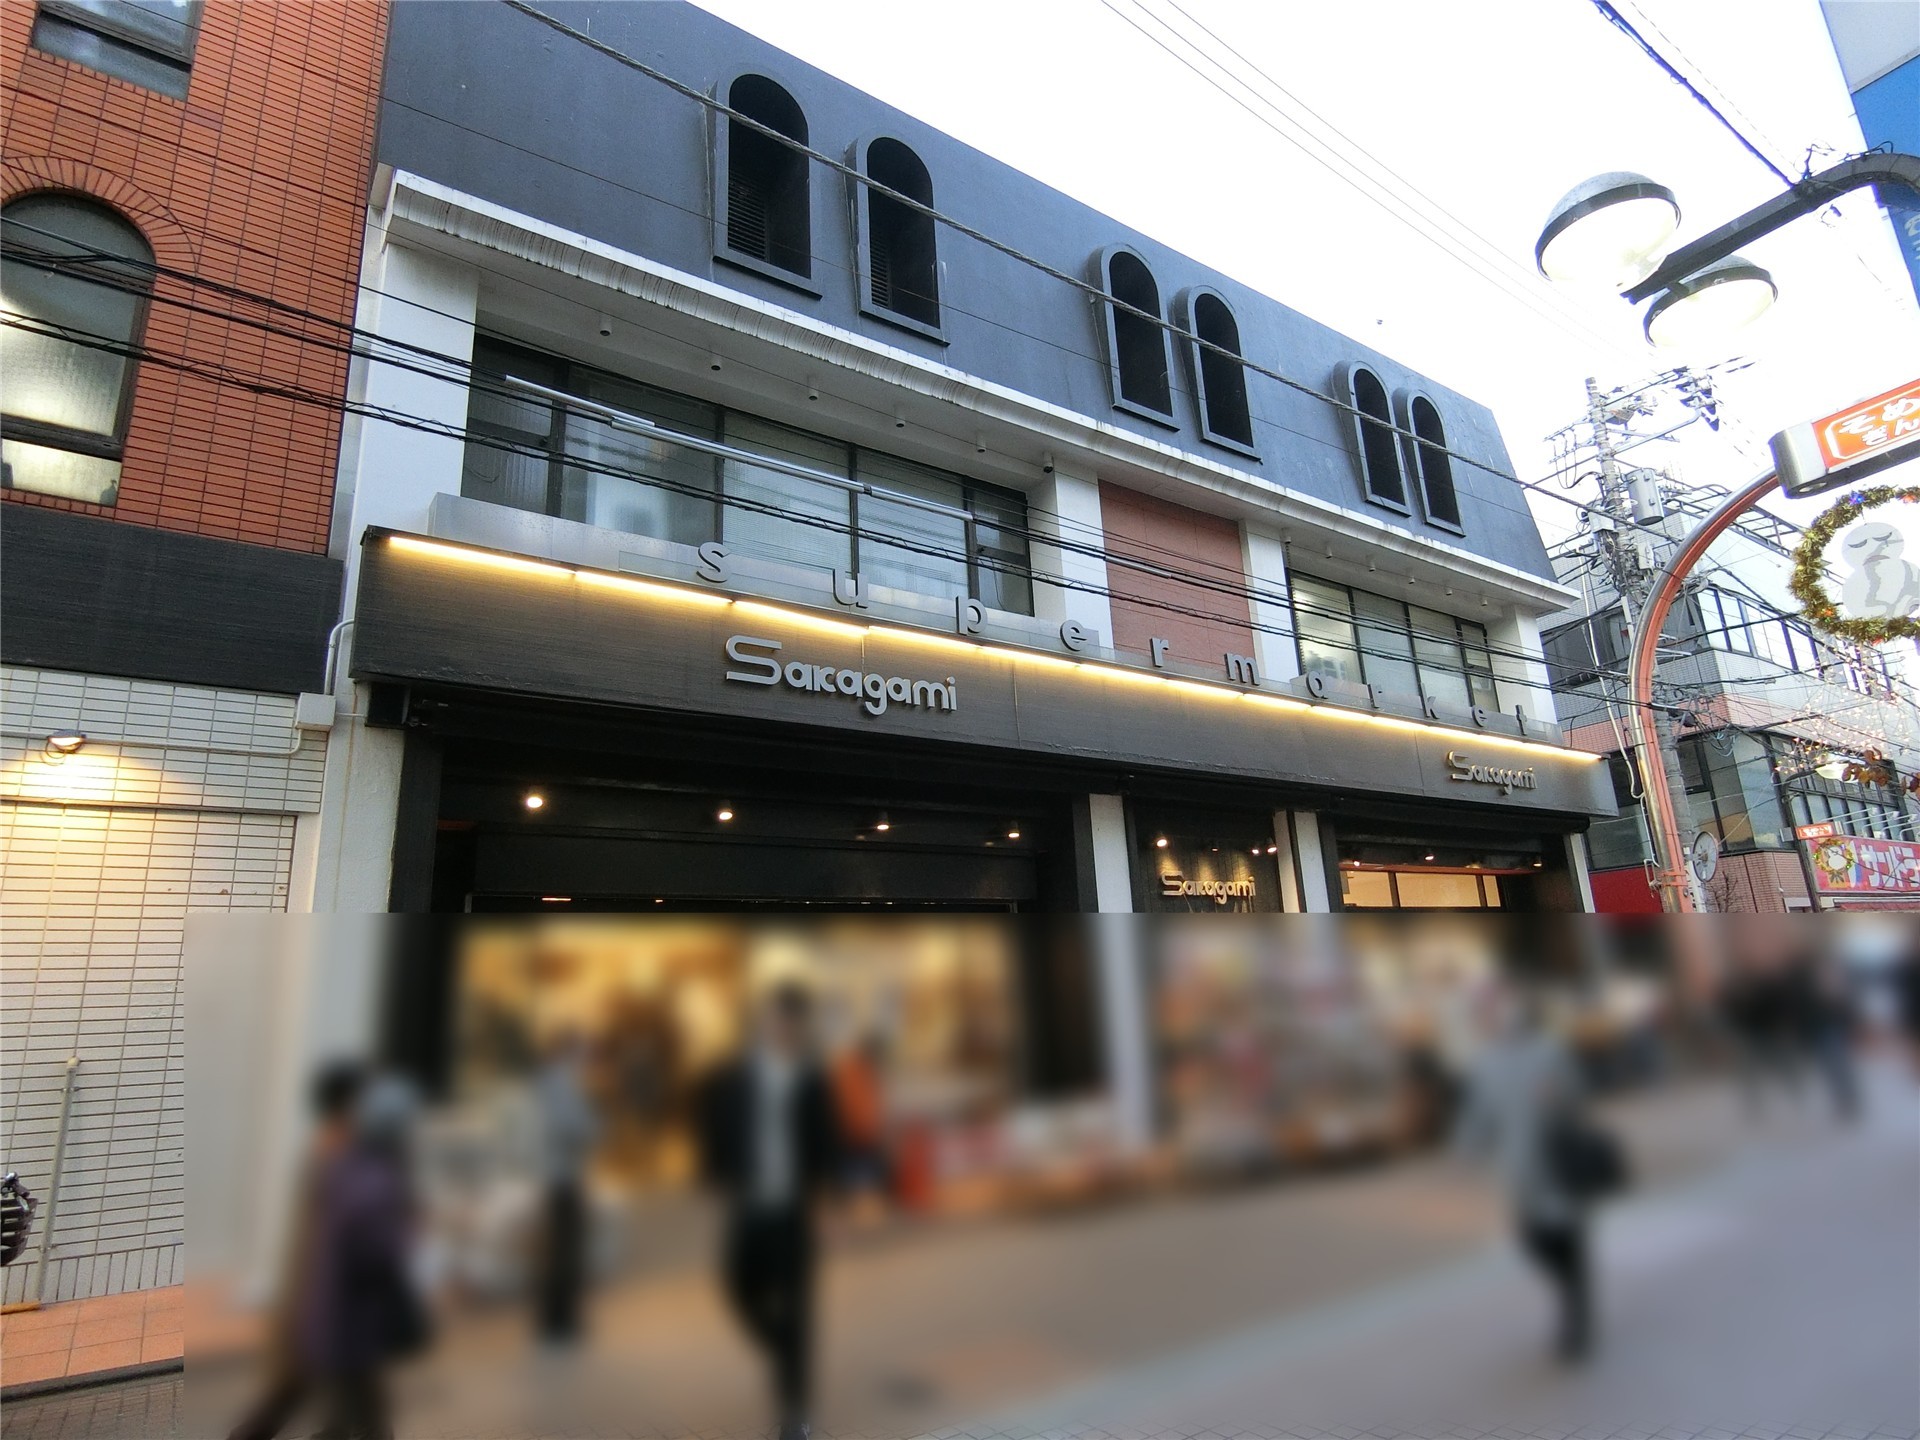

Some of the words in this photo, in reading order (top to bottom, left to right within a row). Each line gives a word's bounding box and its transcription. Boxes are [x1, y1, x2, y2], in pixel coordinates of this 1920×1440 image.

[725, 634, 958, 716] Sakagami
[1448, 751, 1538, 795] Sakagami
[1161, 871, 1257, 905] Sakagami
